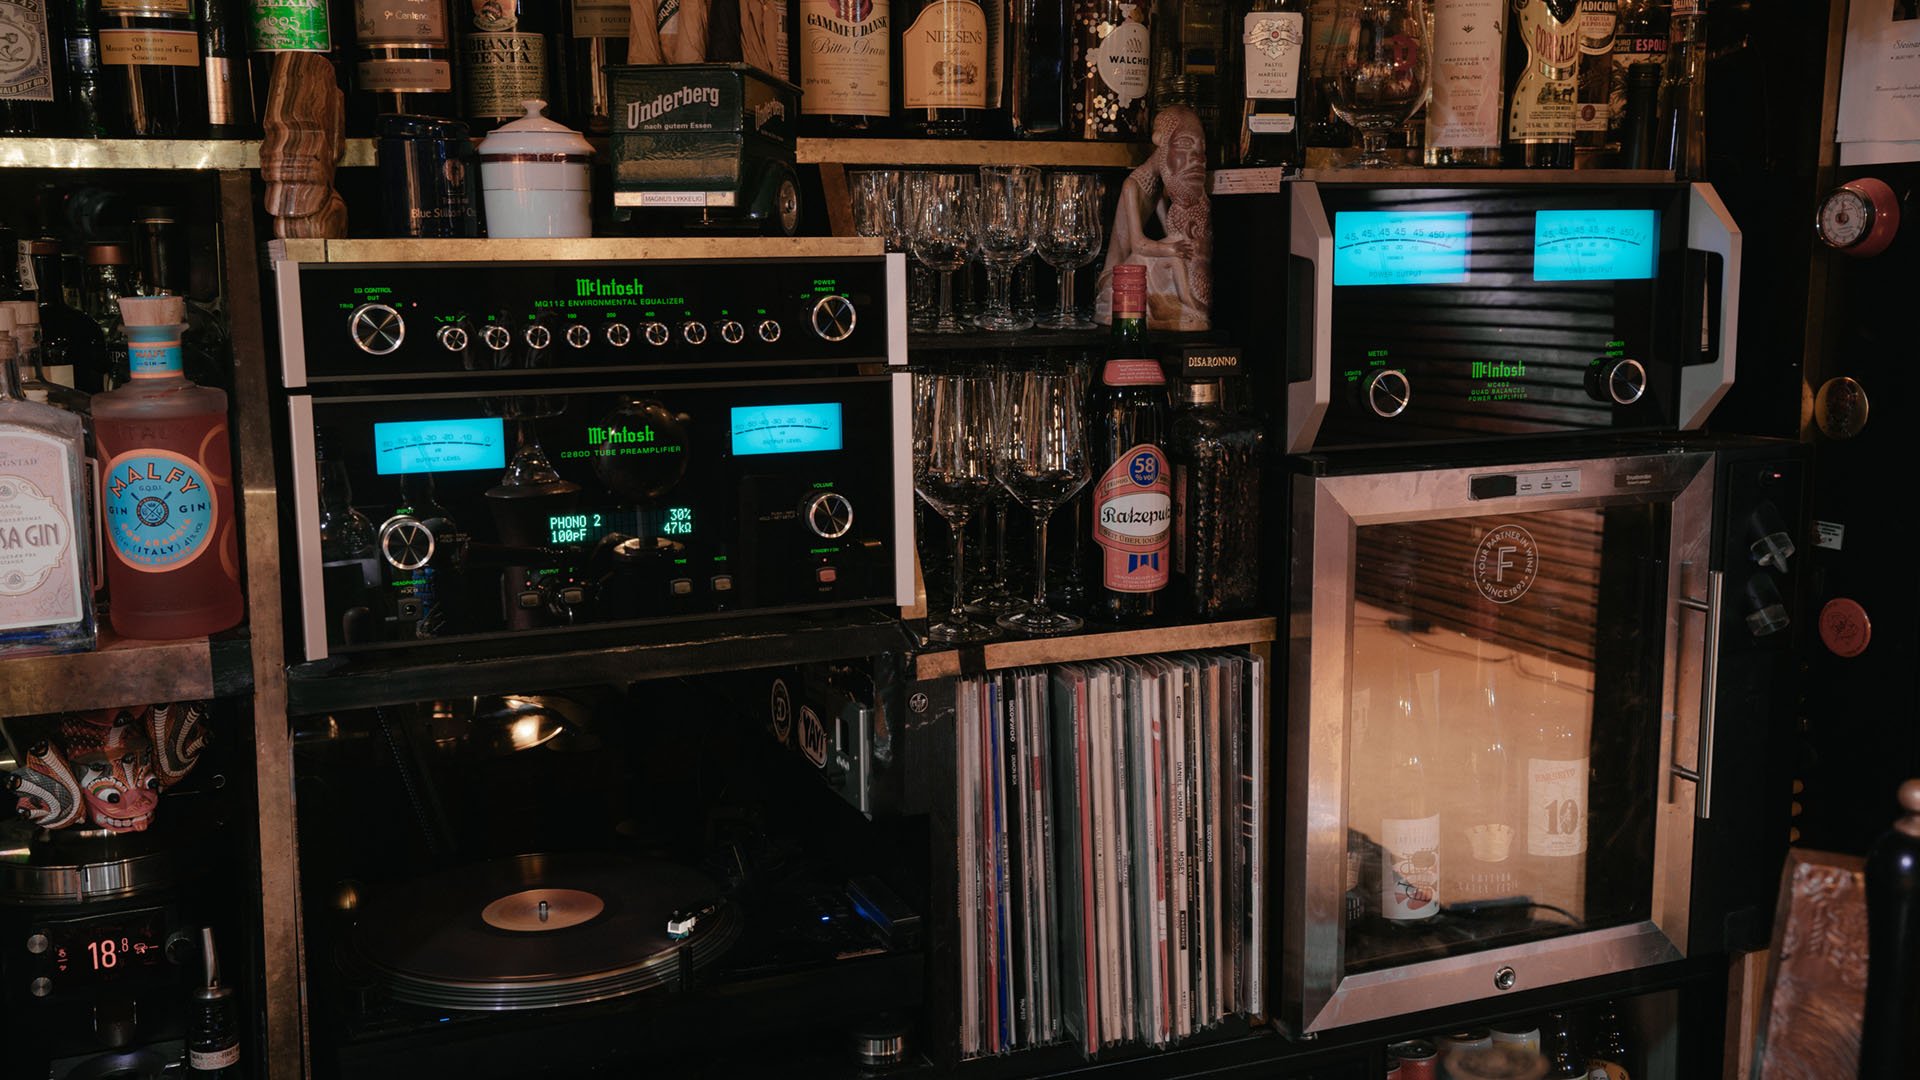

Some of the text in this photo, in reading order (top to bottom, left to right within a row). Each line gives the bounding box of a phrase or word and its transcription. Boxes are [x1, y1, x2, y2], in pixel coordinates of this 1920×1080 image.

[811, 38, 851, 56] Bitter
[626, 85, 720, 130] Underberg
[644, 122, 662, 130] nach
[664, 123, 688, 131] gutem
[411, 207, 432, 218] Blue
[576, 278, 644, 296] McIntosh
[535, 300, 566, 308] MQ112
[568, 299, 638, 307] ENVIRONMENTAL
[1188, 356, 1237, 368] DISARONNO
[1472, 360, 1526, 378] McIntosh
[1492, 386, 1526, 394] BALANCED
[588, 425, 654, 445] McIntosh
[561, 446, 681, 459] C2800 TUBE PREAMPLIFIER
[1134, 457, 1155, 474] 58
[110, 463, 200, 499] MALFY
[109, 502, 206, 515] GIN GIN
[550, 508, 692, 530] PHONO 2 30%
[25, 523, 60, 547] GIN
[144, 518, 192, 546] ARANCIA
[551, 522, 692, 543] 100pF 47kΩ
[1478, 530, 1534, 577] YOUR PARTNER IN WINE
[1496, 546, 1517, 582] F
[1484, 580, 1526, 598] SINCE 1893
[1544, 799, 1578, 834] 10
